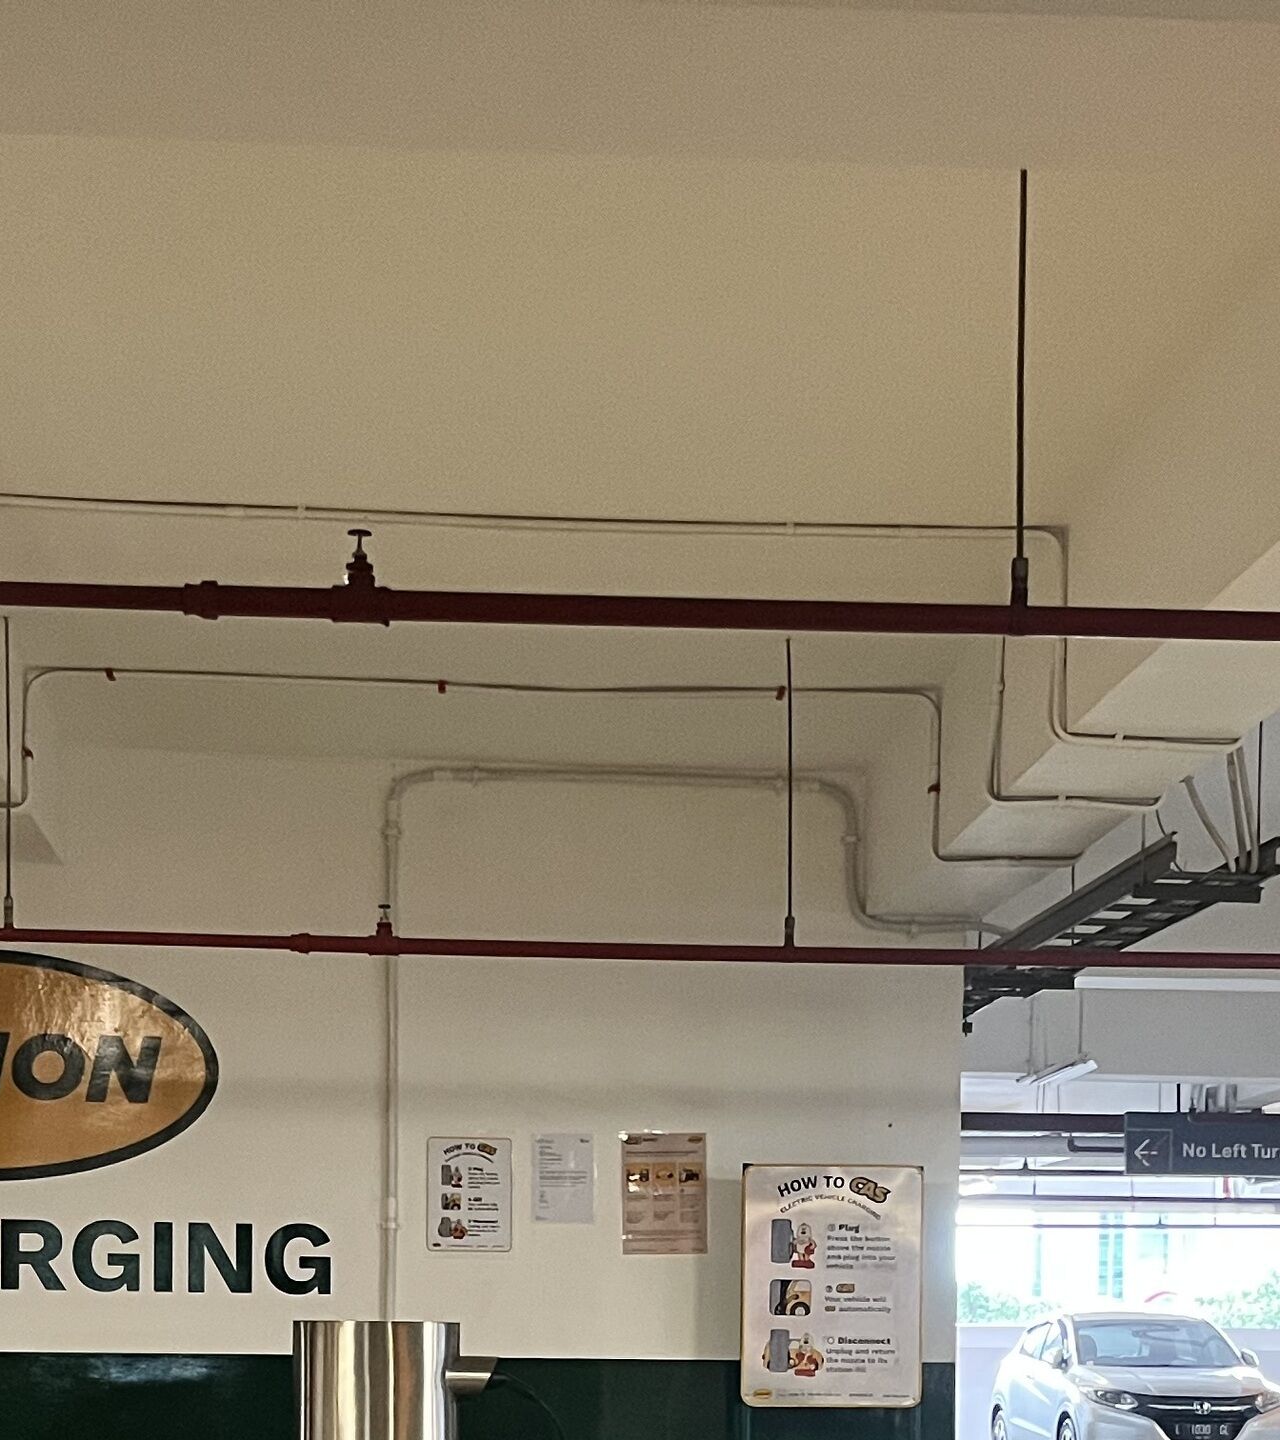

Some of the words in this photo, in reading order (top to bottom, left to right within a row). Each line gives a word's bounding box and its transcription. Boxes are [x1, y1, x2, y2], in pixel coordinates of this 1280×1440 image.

[1183, 1143, 1206, 1158] No
[1212, 1143, 1247, 1158] Left
[777, 1175, 818, 1197] HOW
[823, 1176, 845, 1189] TO
[849, 1176, 892, 1203] CAS
[838, 1336, 891, 1345] Disconnect
